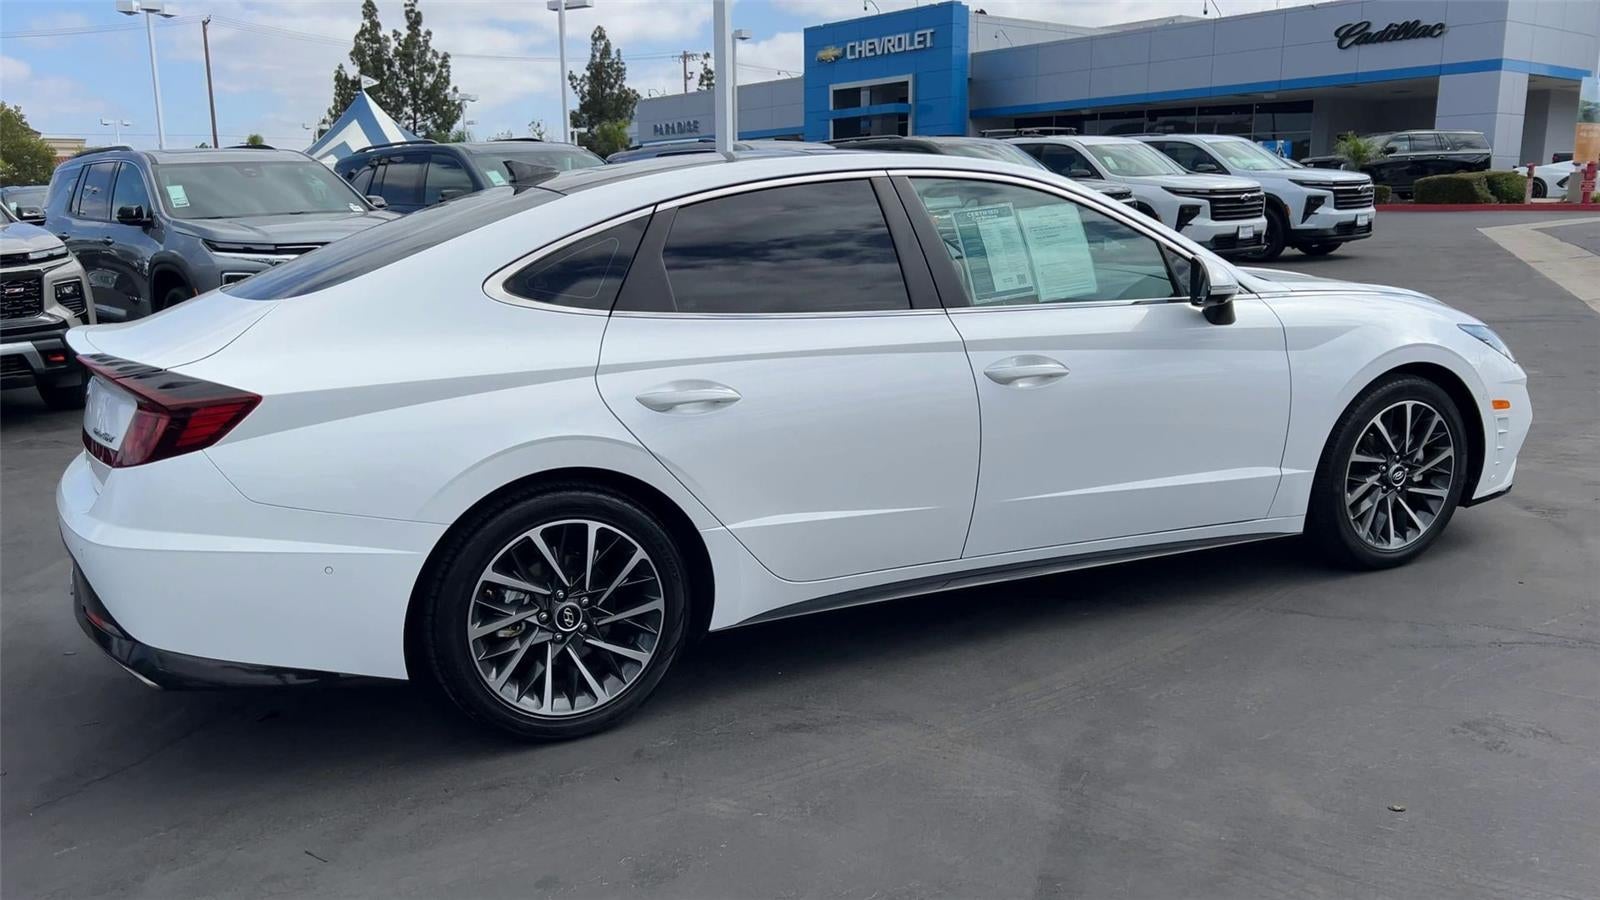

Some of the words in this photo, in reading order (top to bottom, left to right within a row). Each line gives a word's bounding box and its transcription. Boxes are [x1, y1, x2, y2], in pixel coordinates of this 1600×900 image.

[846, 29, 934, 60] CHEVROLET
[1334, 19, 1445, 50] Cadillac
[653, 119, 700, 137] PARADISE
